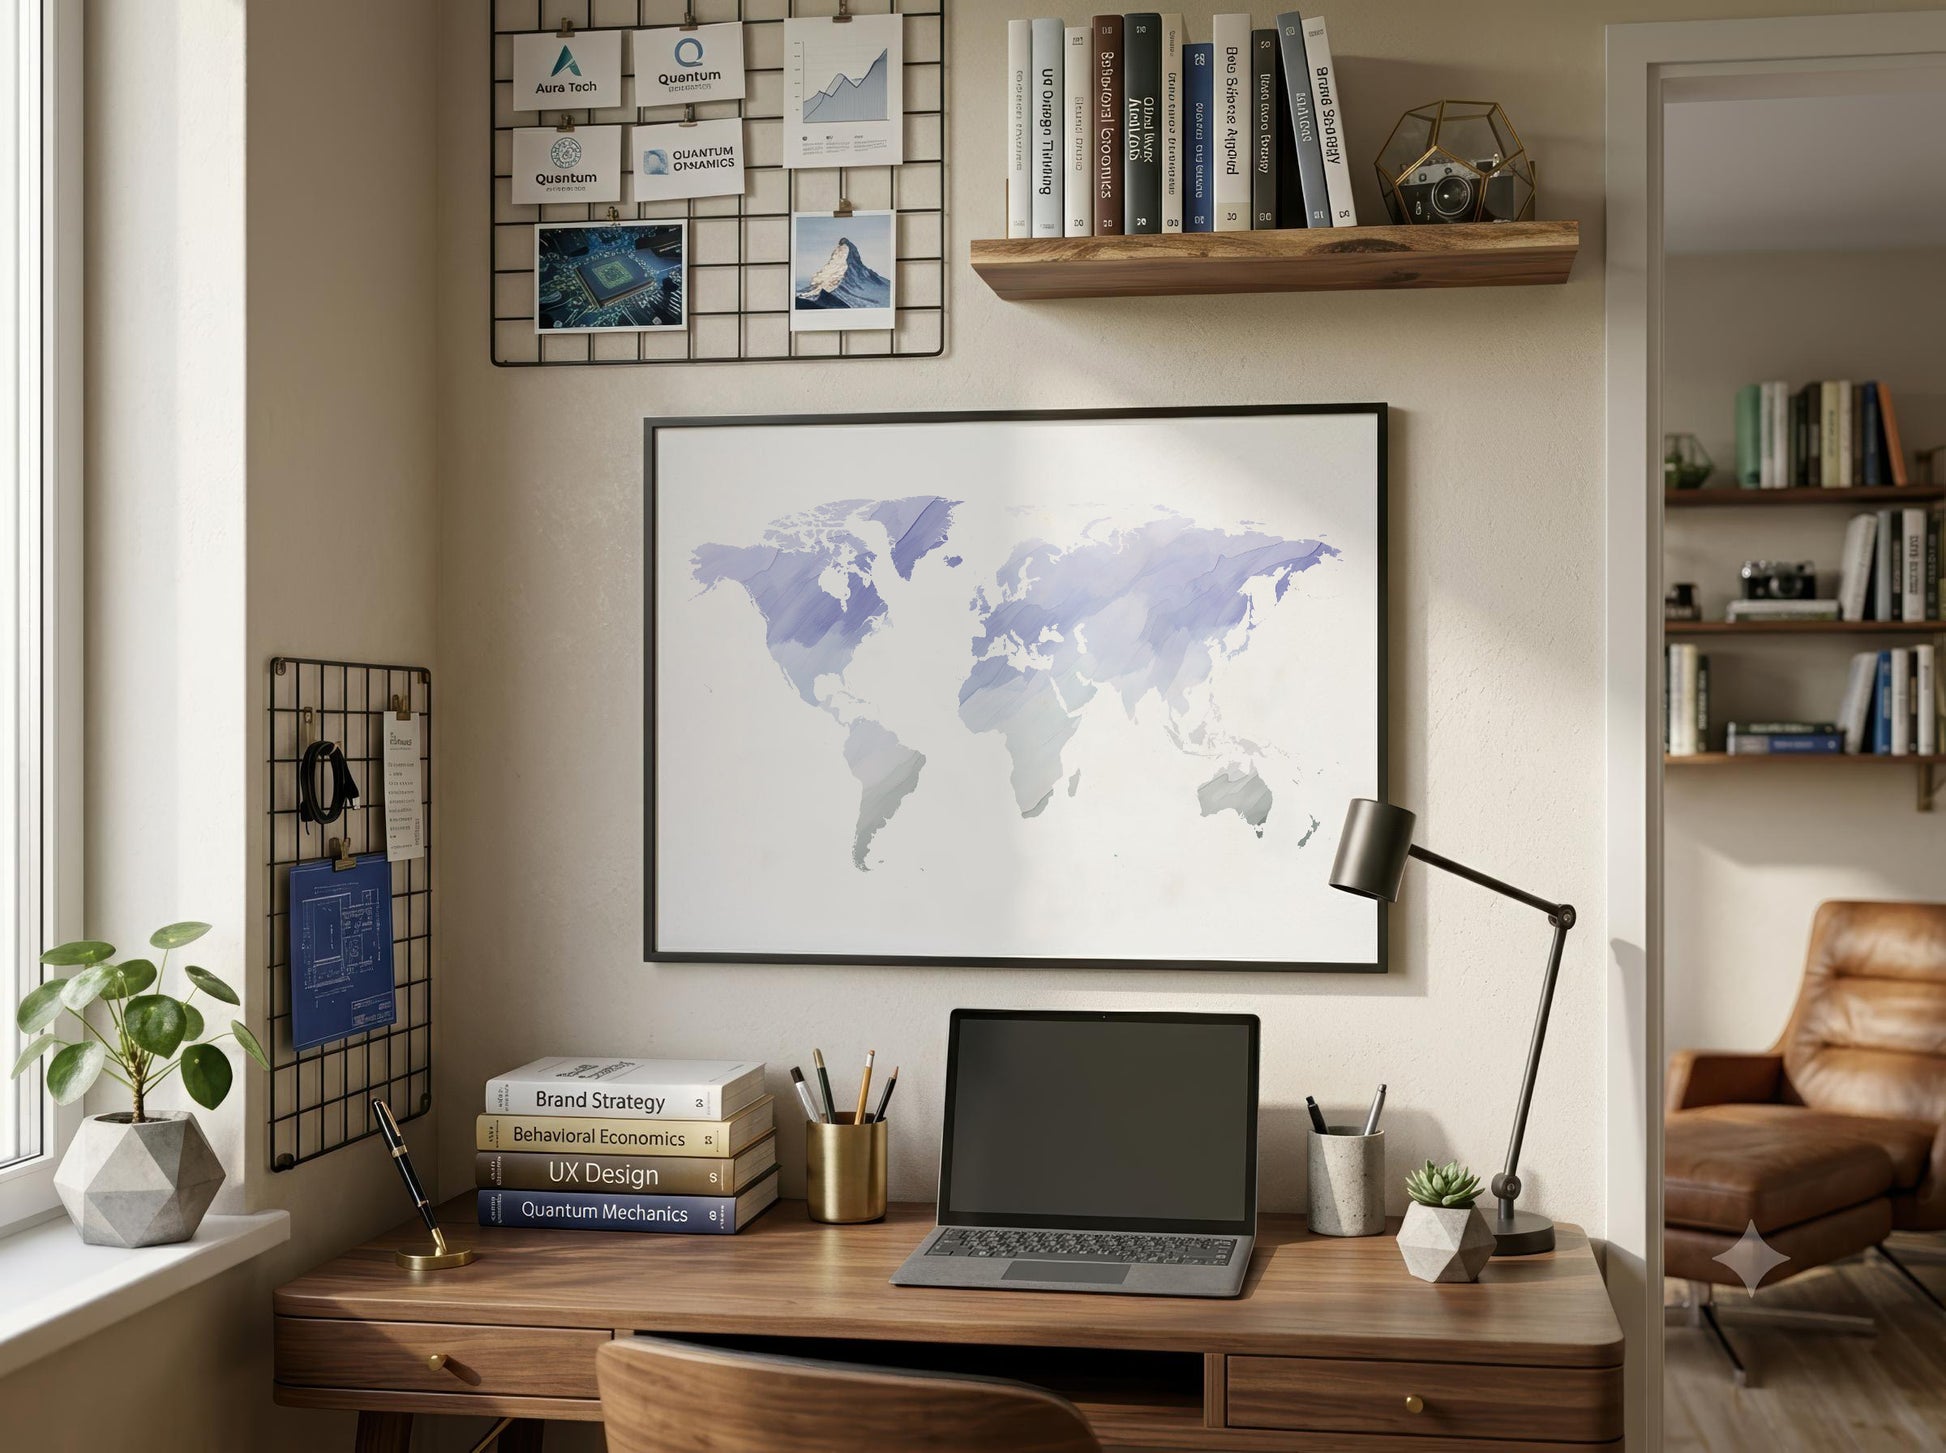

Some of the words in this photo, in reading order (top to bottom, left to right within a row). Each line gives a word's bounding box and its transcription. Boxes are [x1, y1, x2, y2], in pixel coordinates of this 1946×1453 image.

[535, 82, 565, 94] Aura
[536, 1091, 587, 1108] Brand
[592, 1092, 665, 1115] Strategy
[513, 1126, 595, 1144] Behavioral
[600, 1129, 686, 1147] Economics
[549, 1161, 579, 1183] UX
[586, 1164, 659, 1190] Design
[521, 1201, 598, 1219] Quantum
[602, 1204, 688, 1223] Mechanics
